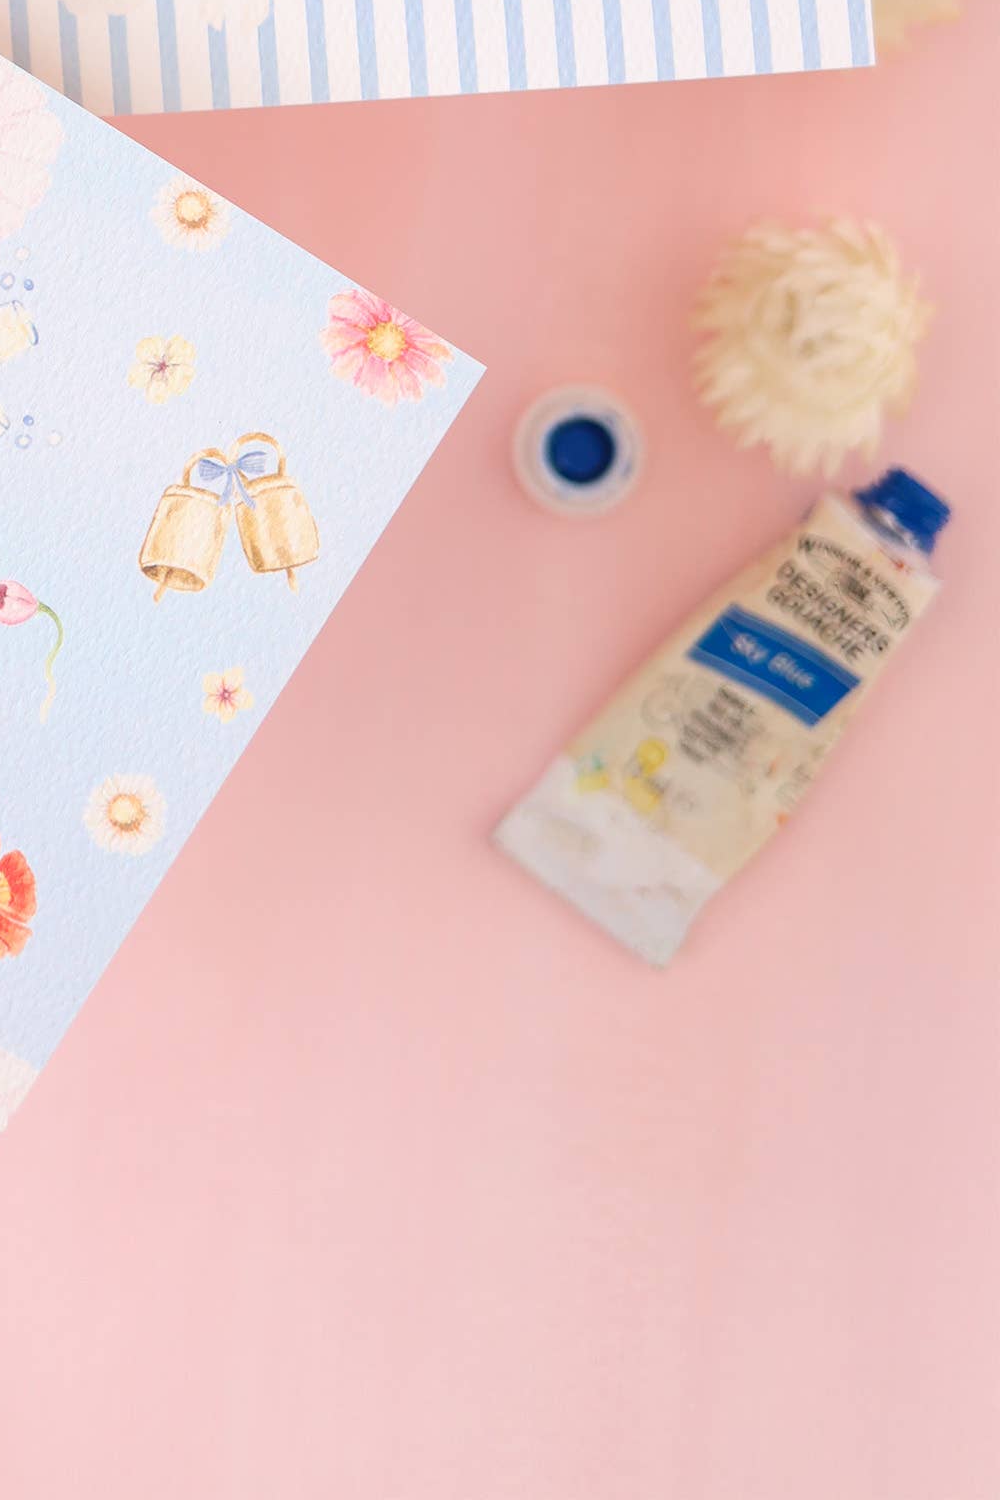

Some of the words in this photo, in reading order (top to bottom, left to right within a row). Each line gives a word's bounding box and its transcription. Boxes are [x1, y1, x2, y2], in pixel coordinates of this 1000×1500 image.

[766, 583, 864, 661] GOUACHE
[776, 558, 889, 655] DESIGNERS
[731, 632, 768, 666] Sky
[768, 651, 816, 689] Blue
